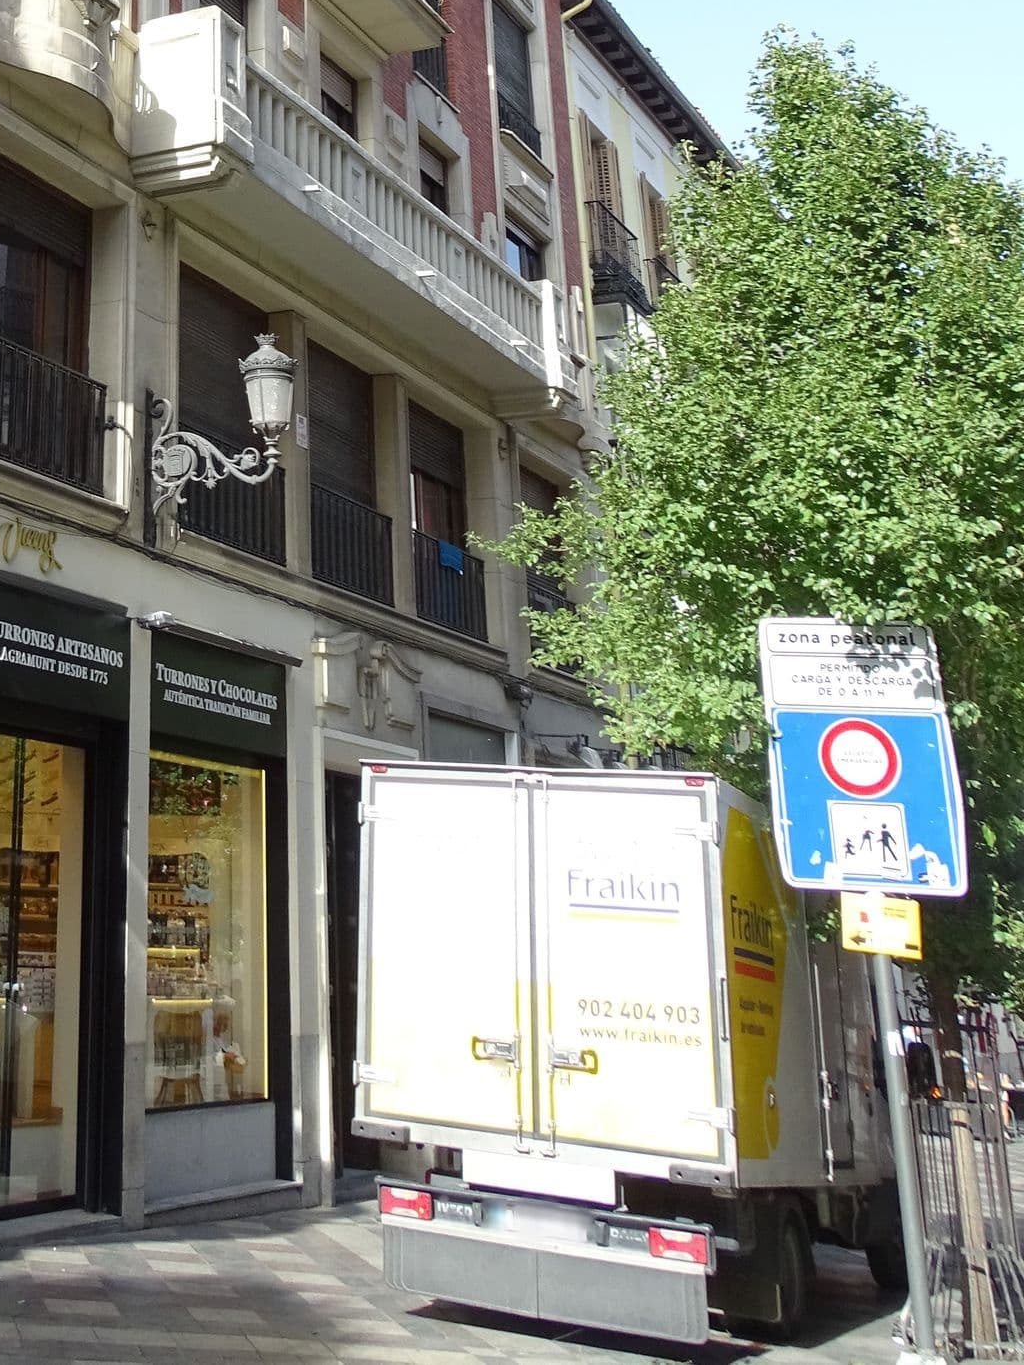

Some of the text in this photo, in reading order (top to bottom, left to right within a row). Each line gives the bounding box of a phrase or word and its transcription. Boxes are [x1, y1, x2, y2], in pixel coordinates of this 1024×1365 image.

[778, 632, 916, 647] zona peatonal
[55, 636, 124, 668] ARTESANOS
[0, 646, 108, 685] AGRAMUNT DESDE 1775
[820, 663, 881, 673] PERMITIDO
[156, 662, 278, 710] TURRONES Y CHOCOLATES
[791, 675, 913, 686] CARGA Y DESCARGA
[818, 687, 832, 696] DE
[852, 688, 859, 697] A
[864, 689, 872, 697] 11
[877, 689, 885, 697] H
[163, 688, 205, 710] AUTÉNTICA
[568, 869, 680, 902] Fraikin
[730, 894, 774, 952] Fraikin
[578, 999, 701, 1025] 902 404 903
[579, 1027, 702, 1047] www.fraikin.es
